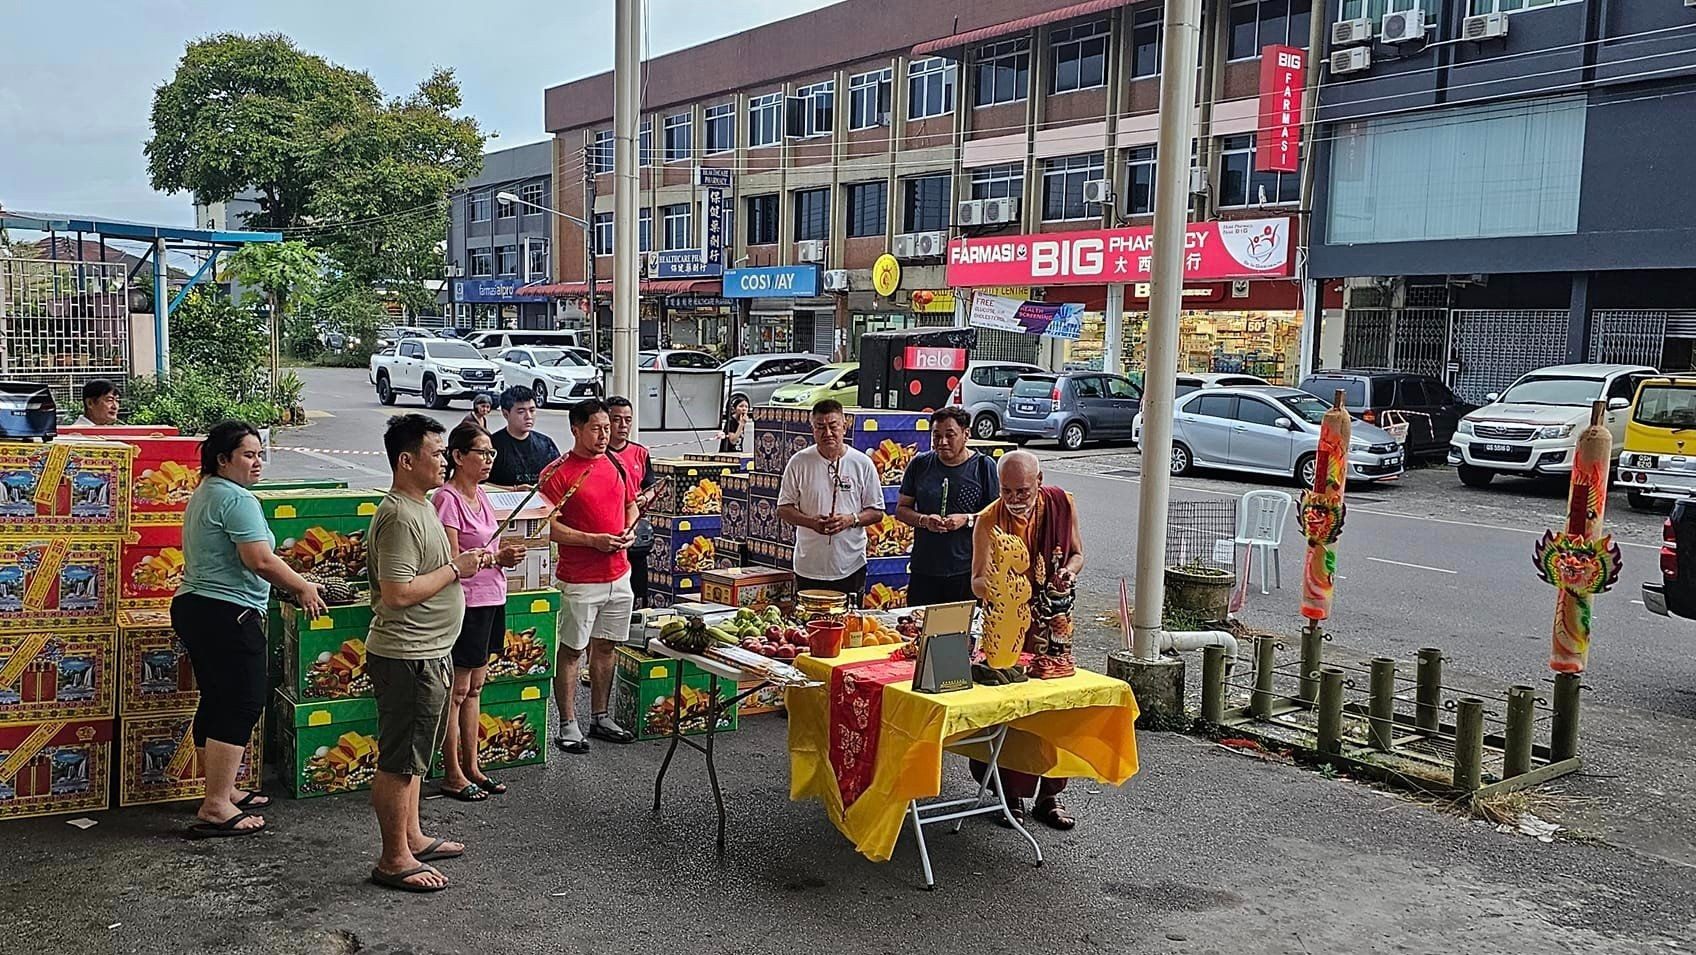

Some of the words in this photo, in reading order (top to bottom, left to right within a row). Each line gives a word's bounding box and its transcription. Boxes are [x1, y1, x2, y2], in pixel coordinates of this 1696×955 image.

[1278, 52, 1301, 69] BIG
[1280, 73, 1292, 165] FARMASI
[951, 244, 1015, 265] FARMASI
[1031, 238, 1104, 277] BIG
[1109, 231, 1209, 252] PHARCY
[1114, 251, 1202, 274] 大西行
[741, 272, 795, 290] COSWAY
[976, 298, 994, 307] FREE
[1020, 305, 1044, 314] HEALTH
[1018, 311, 1053, 321] SCREENING
[916, 349, 952, 367] helo
